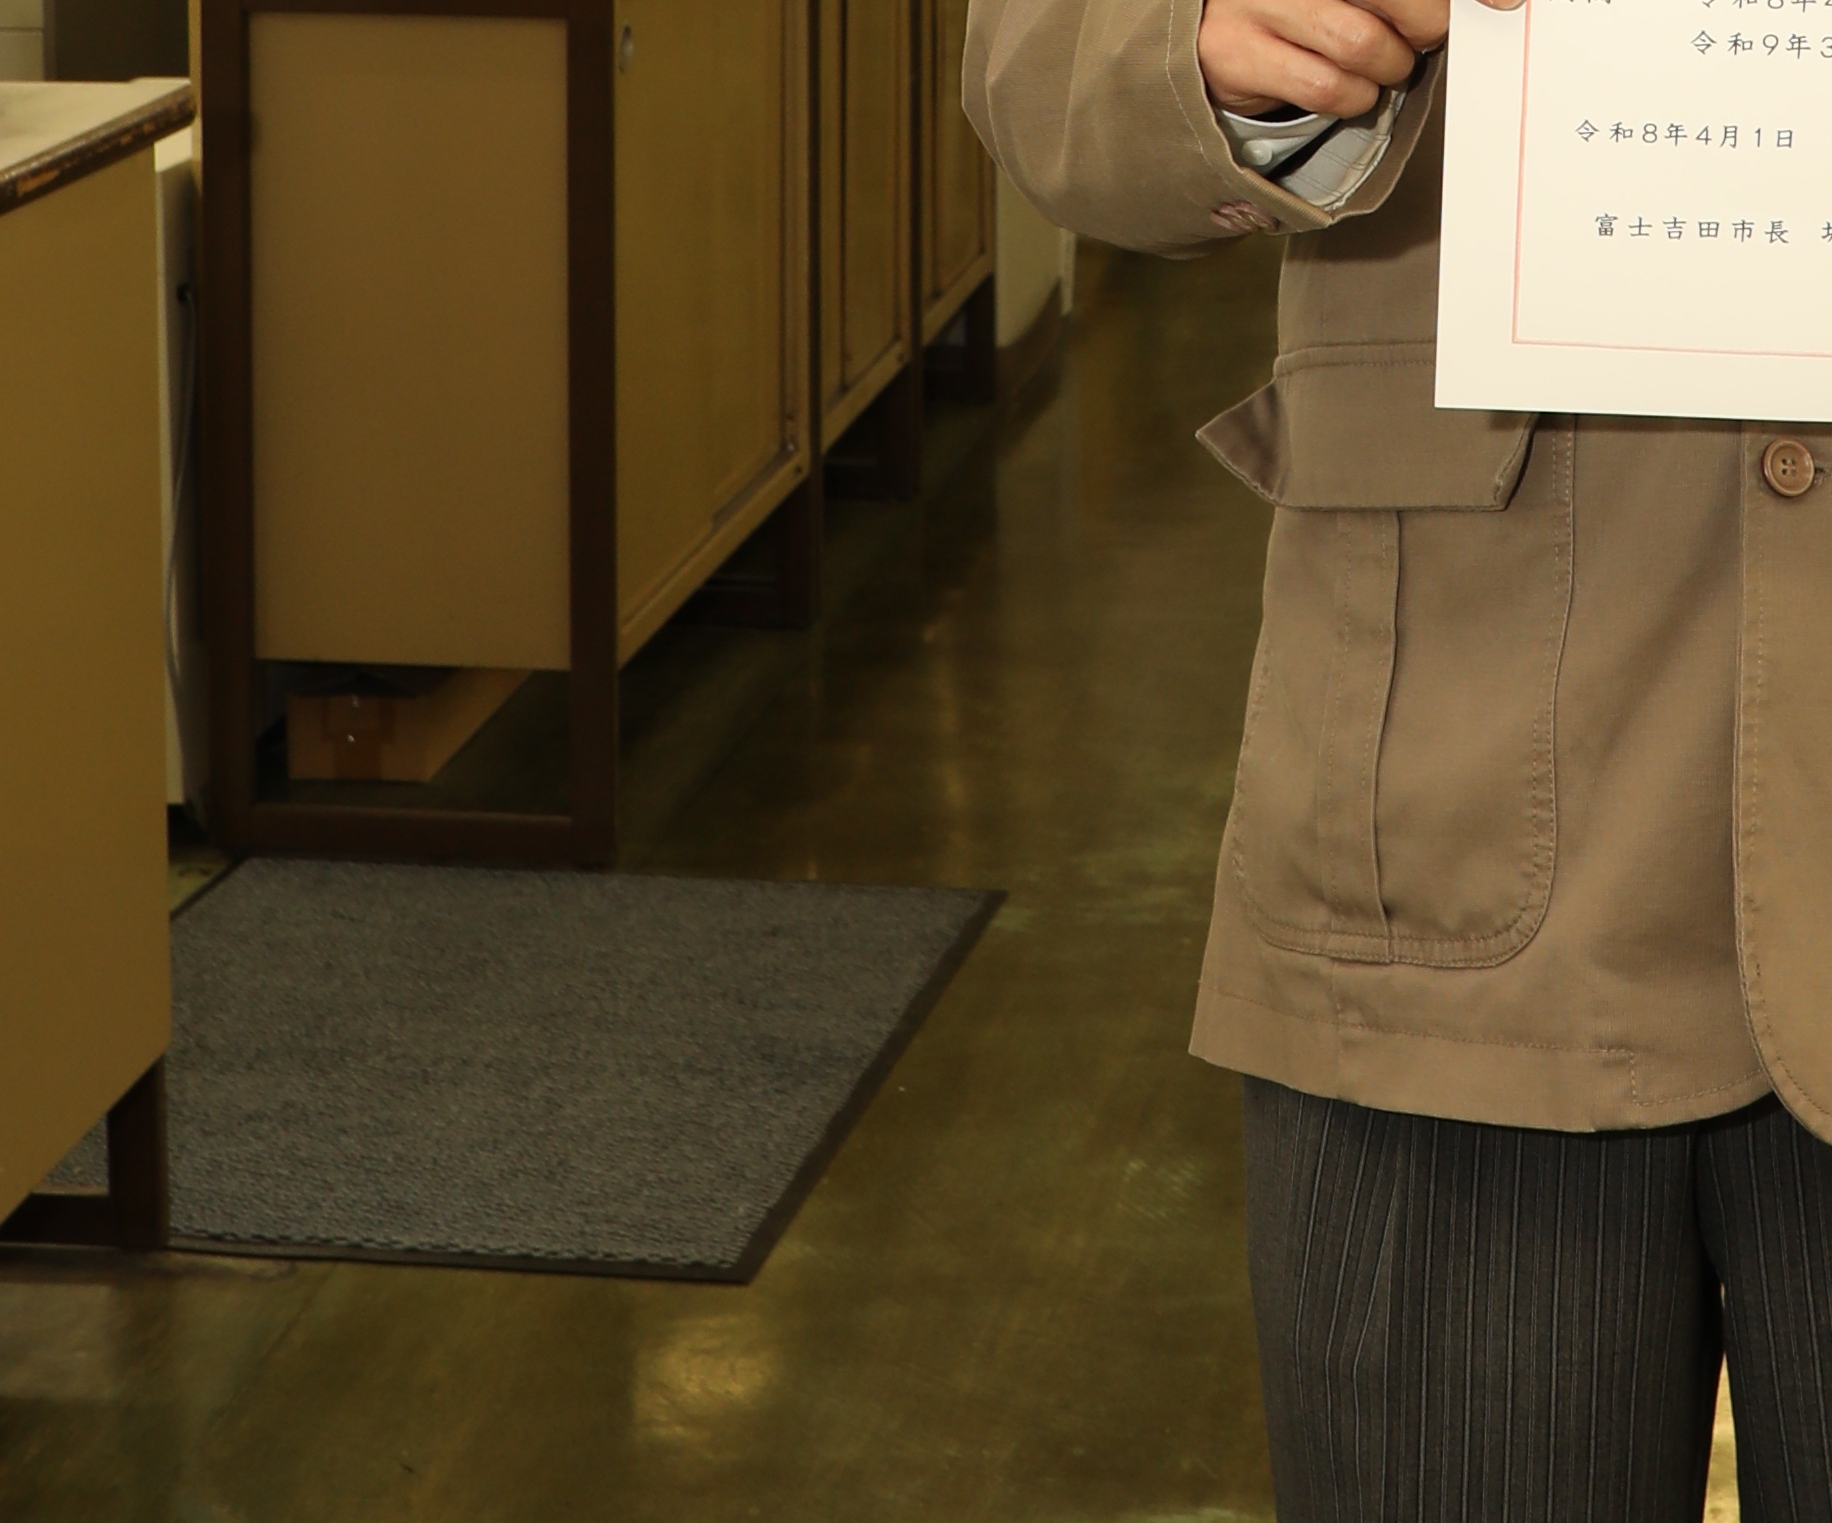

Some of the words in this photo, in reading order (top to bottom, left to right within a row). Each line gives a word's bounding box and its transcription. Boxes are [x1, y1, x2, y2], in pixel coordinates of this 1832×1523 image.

[1574, 118, 1794, 150] 令和8年4月1日
[1593, 212, 1790, 245] 富士吉田市長
